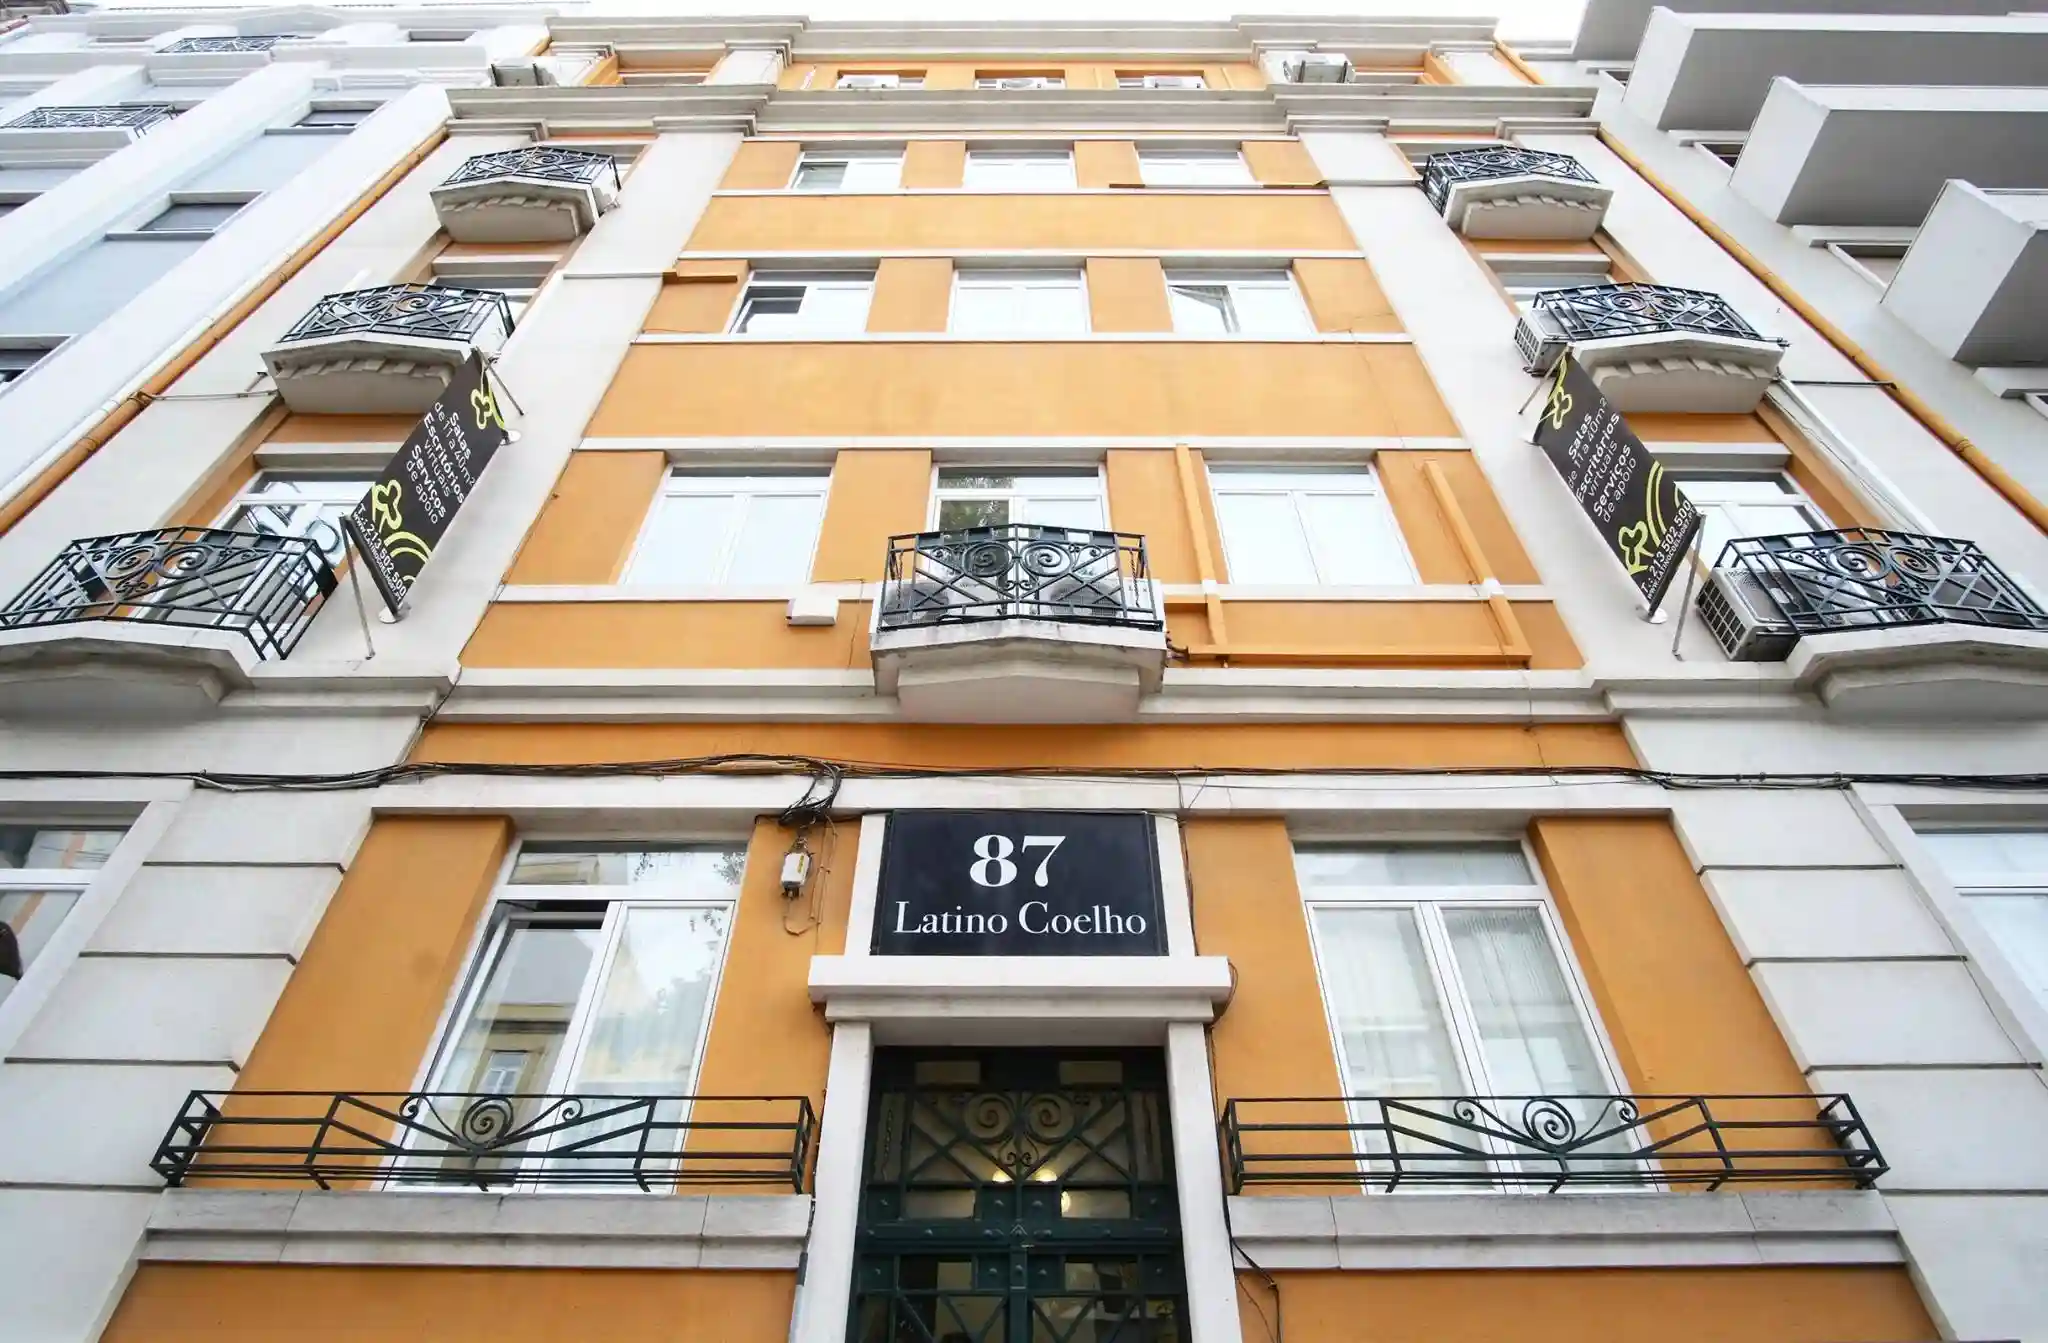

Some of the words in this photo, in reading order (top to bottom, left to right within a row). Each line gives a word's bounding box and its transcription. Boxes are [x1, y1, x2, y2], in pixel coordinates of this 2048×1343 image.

[434, 402, 445, 421] de
[443, 420, 453, 438] 11
[448, 439, 456, 450] a
[450, 412, 471, 460] Salas
[1568, 413, 1592, 460] Salas
[411, 444, 446, 518] Serviços
[424, 412, 464, 504] Escritórios
[424, 439, 452, 497] virtuais
[1568, 470, 1578, 489] de
[1574, 452, 1584, 468] 11
[1582, 443, 1589, 454] a
[1576, 413, 1620, 503] Escritórios
[1588, 440, 1618, 497] virtuais
[1593, 444, 1630, 516] Serviços
[406, 460, 419, 482] de
[416, 483, 438, 524] apoio
[1603, 502, 1615, 523] de
[1614, 457, 1636, 501] apoio
[366, 523, 382, 549] 213
[380, 547, 394, 574] 502
[392, 572, 407, 596] 500
[1649, 551, 1665, 577] 213
[1661, 526, 1678, 552] 502
[1673, 500, 1691, 527] 500
[969, 834, 1067, 888] 87
[893, 901, 1008, 934] Latino
[1018, 901, 1147, 934] Coelho
